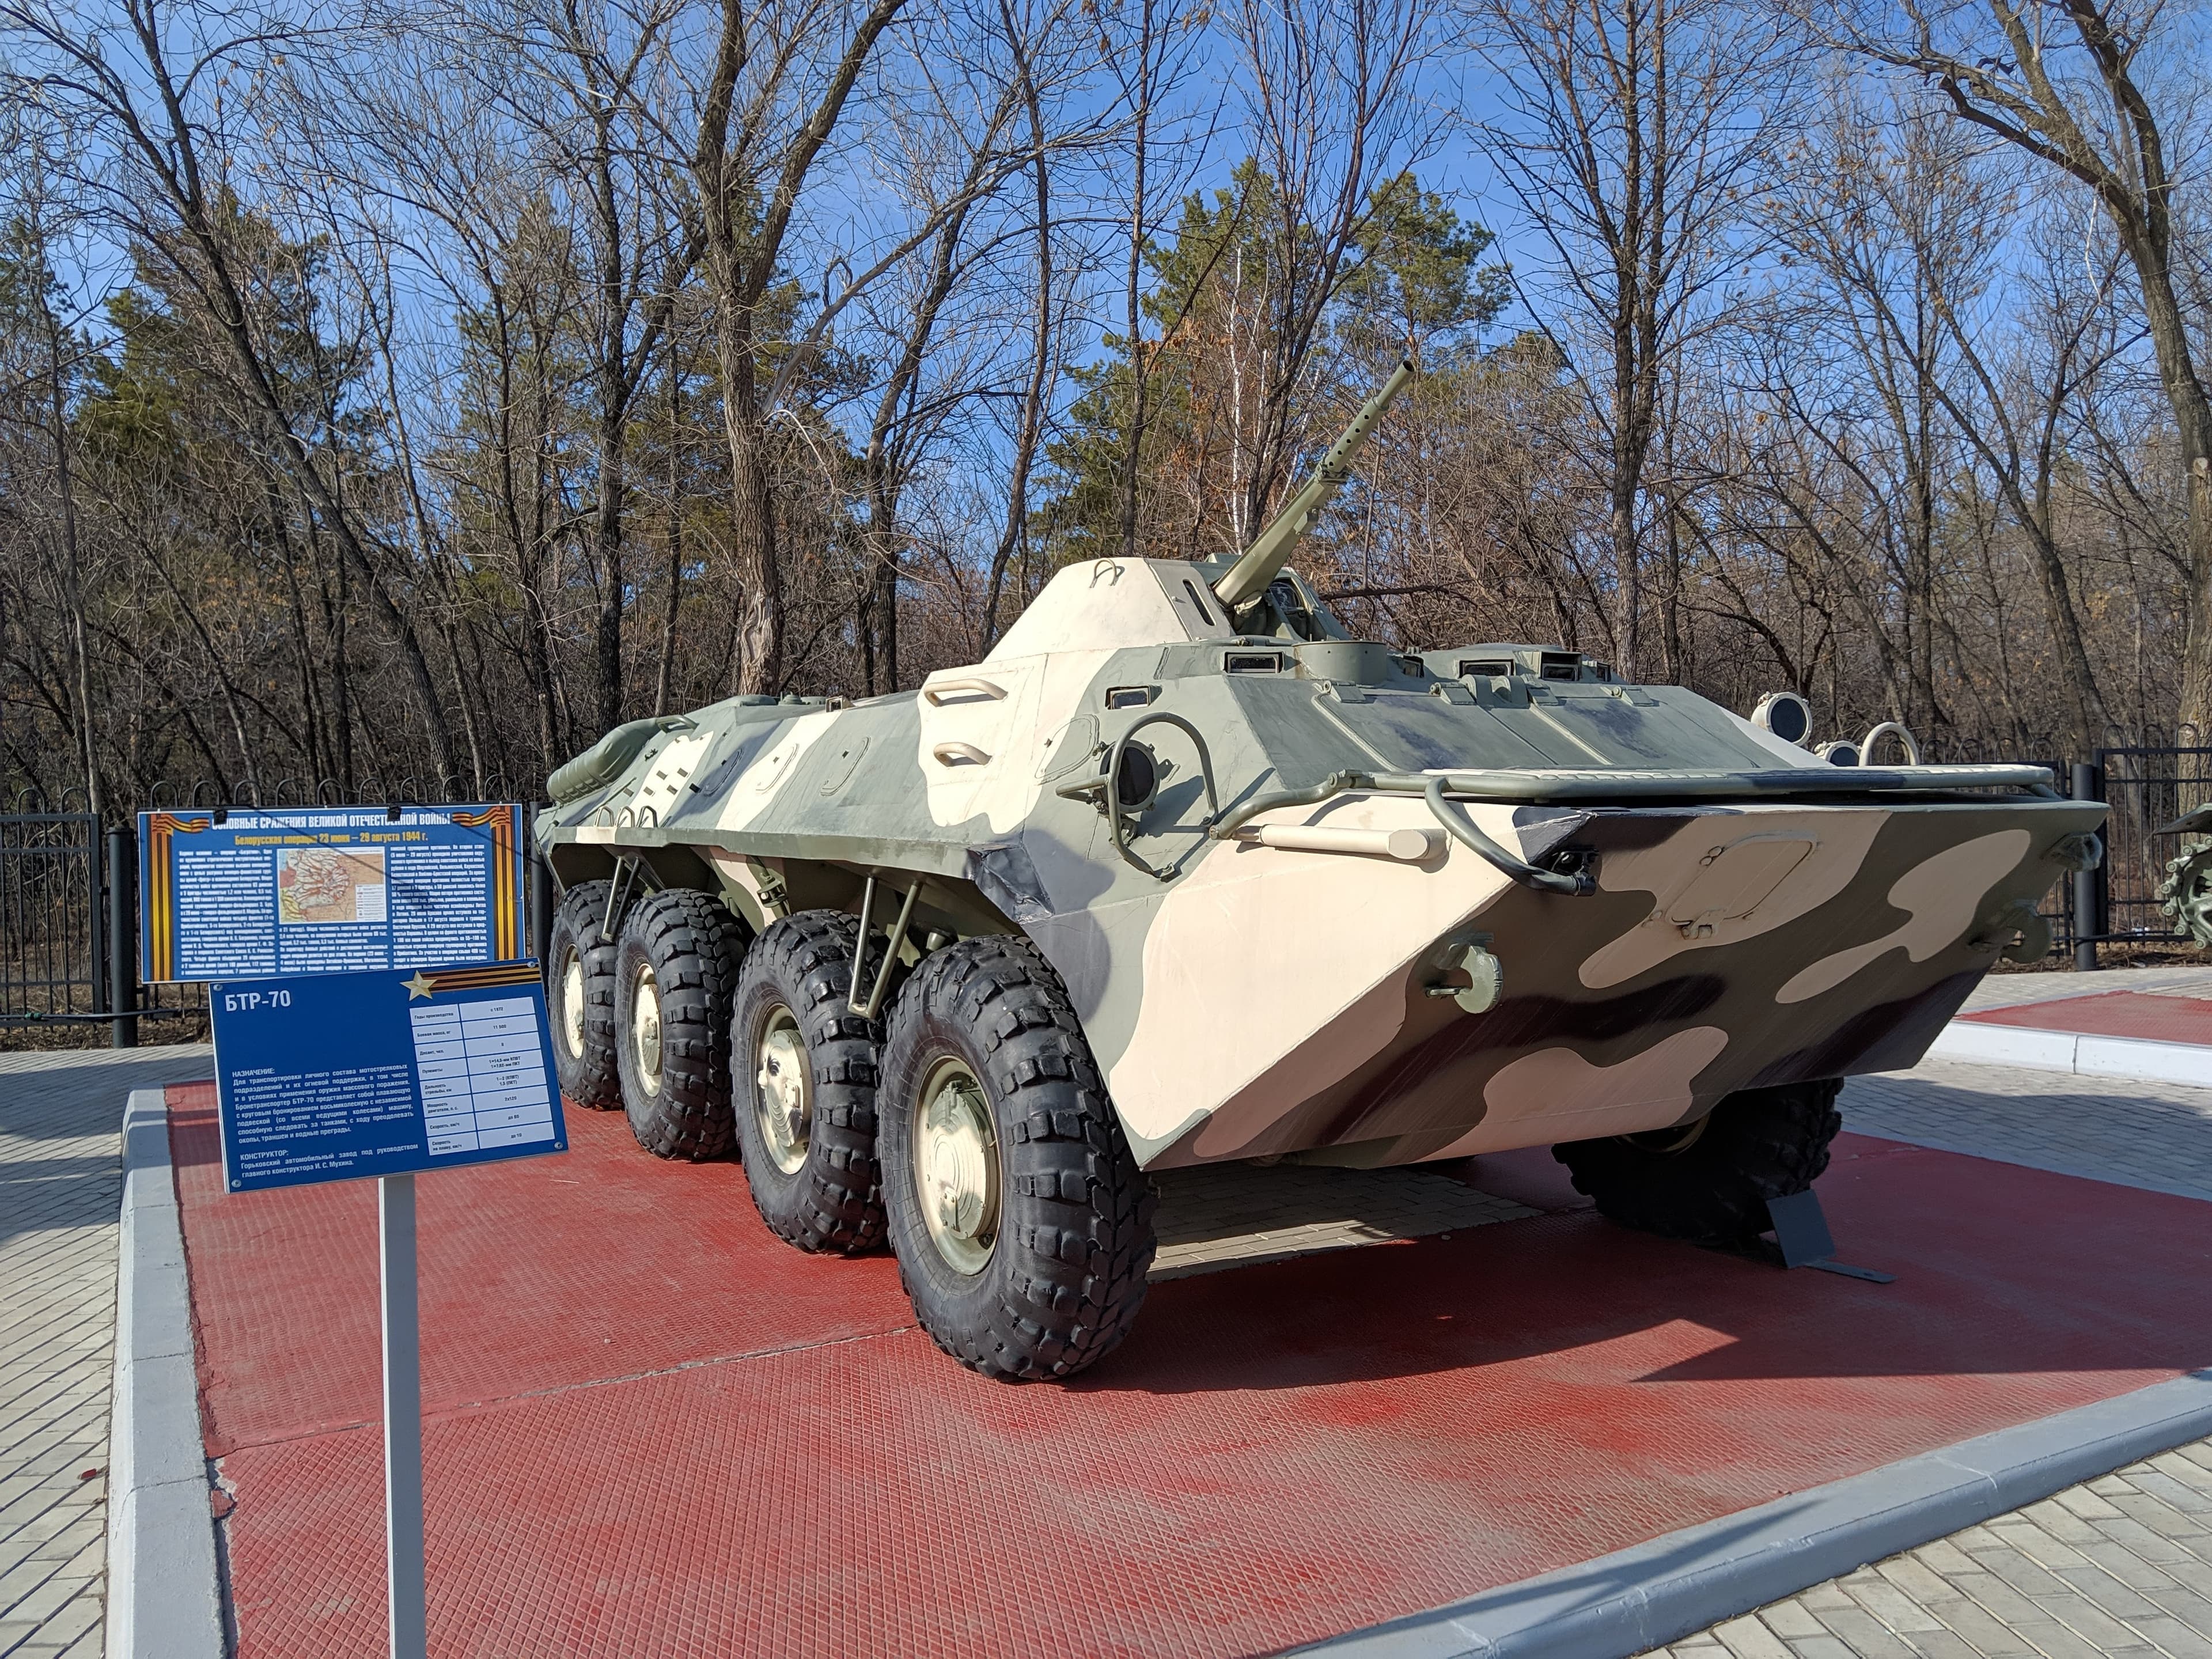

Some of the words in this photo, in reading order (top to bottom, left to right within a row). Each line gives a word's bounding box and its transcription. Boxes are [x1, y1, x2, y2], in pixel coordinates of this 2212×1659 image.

[260, 816, 306, 828] СРАЖЕНИЯ
[308, 814, 347, 827] ВЕЛИКОЙ
[419, 812, 450, 825] ВОЙНЫ
[359, 832, 370, 842] 29
[371, 833, 400, 843] августа
[402, 831, 421, 841] 1944
[422, 832, 428, 840] г.
[225, 990, 291, 1012] БТР-70
[232, 1068, 275, 1077] НАЗНАЧЕНИЕ:
[249, 1074, 302, 1085] транспортировки
[359, 1064, 408, 1073] мотострелковых
[234, 1084, 282, 1094] подразделений
[304, 1079, 329, 1087] огневой
[248, 1093, 277, 1101] условиях
[279, 1089, 316, 1098] применения
[377, 1080, 410, 1088] поражения.
[235, 1100, 291, 1111] Бронетранспортер
[292, 1096, 314, 1104] БТР-70
[316, 1093, 355, 1103] представляет
[376, 1088, 411, 1096] плавающую
[241, 1108, 271, 1118] круговым
[272, 1105, 319, 1115] бронированием
[320, 1100, 369, 1110] восьмиколесную
[374, 1094, 412, 1104] независимой
[237, 1118, 270, 1127] подвеской
[316, 1111, 347, 1119] ведущими
[353, 1106, 383, 1115] колесами)
[238, 1127, 272, 1135] способную
[275, 1123, 308, 1131] следовать
[373, 1112, 414, 1122] преодолевать
[261, 1134, 289, 1142] траншеи
[320, 1127, 351, 1135] преграды.
[240, 1150, 289, 1161] КОНСТРУКТОР:
[241, 1159, 281, 1169] Горьковский
[285, 1153, 335, 1164] автомобильный
[377, 1144, 418, 1154] руководством
[242, 1169, 271, 1178] главного
[272, 1165, 314, 1174] конструктора
